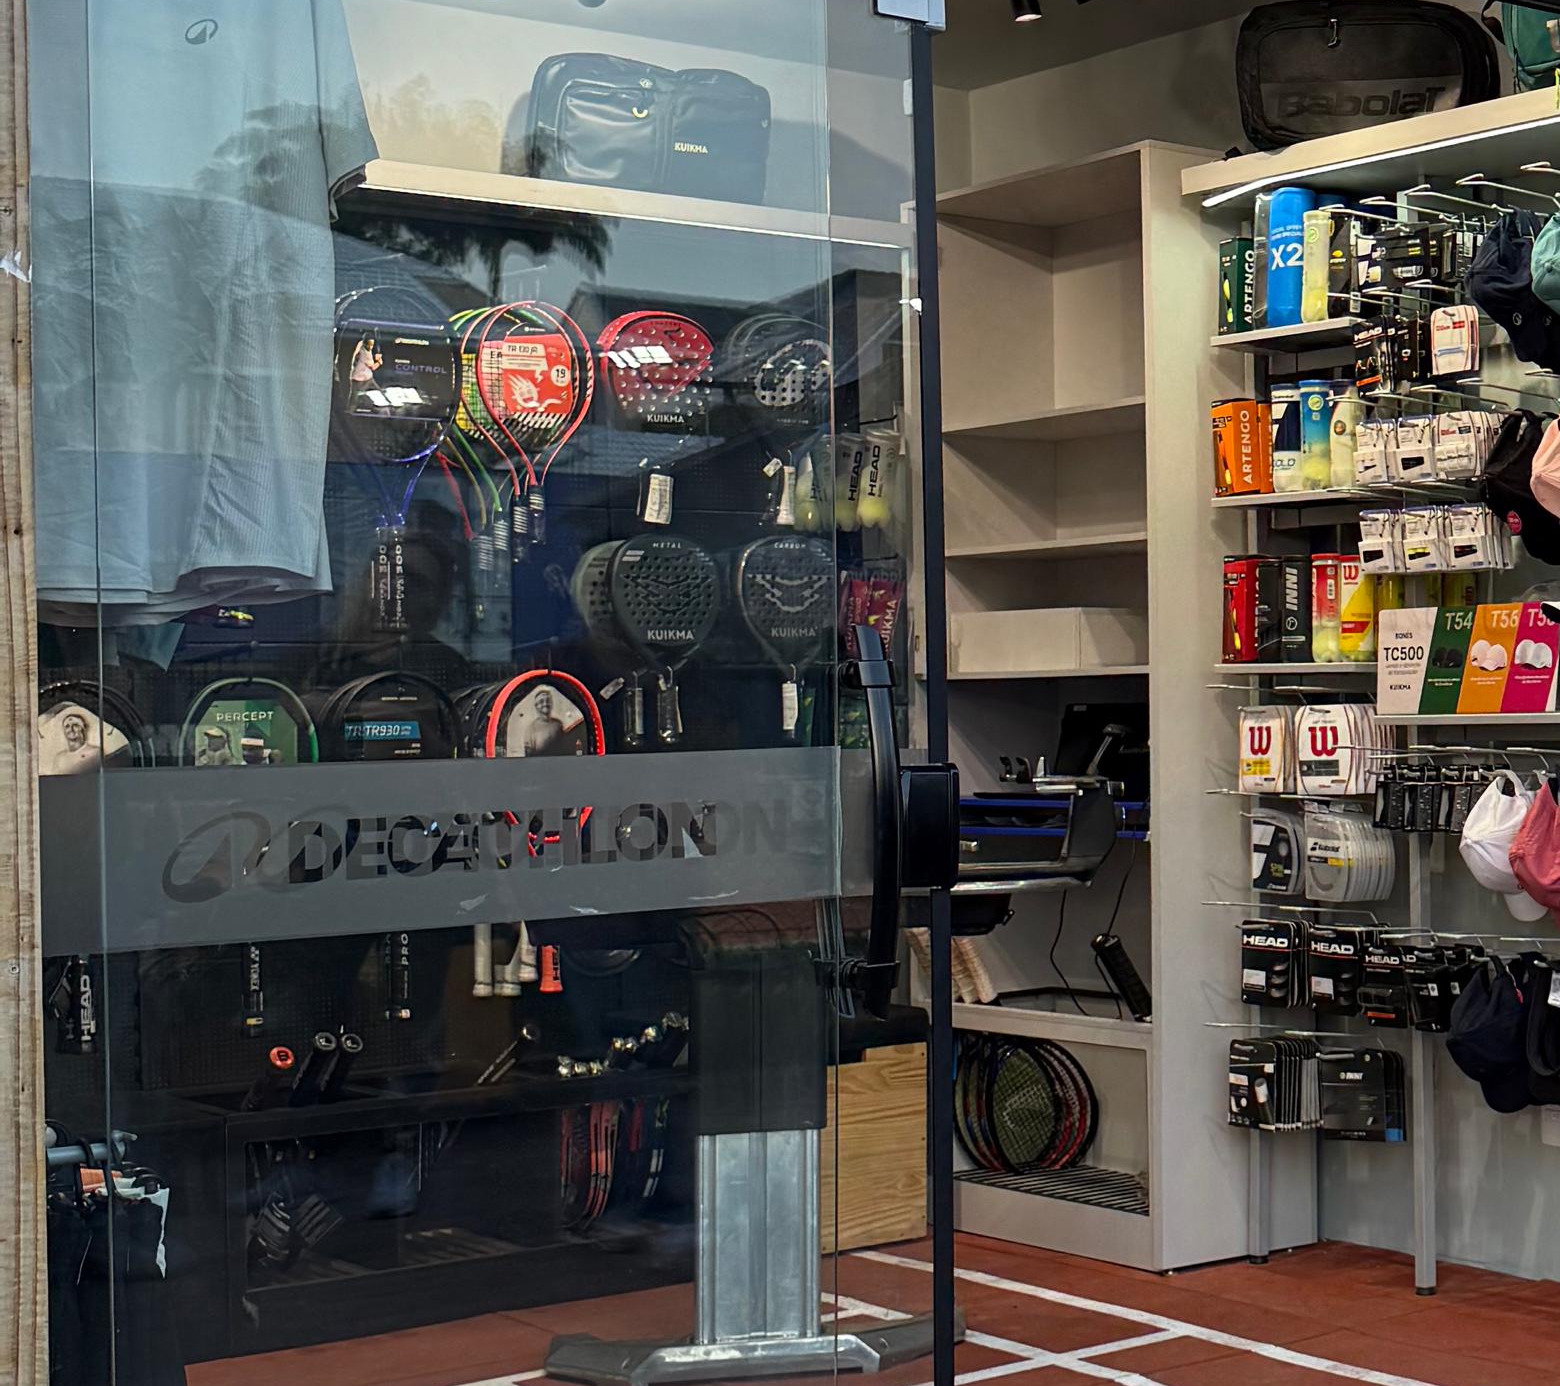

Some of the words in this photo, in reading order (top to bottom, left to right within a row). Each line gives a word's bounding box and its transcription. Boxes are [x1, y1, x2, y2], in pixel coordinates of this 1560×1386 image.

[1270, 243, 1304, 271] X2
[1243, 250, 1255, 324] ARTENGO
[1354, 326, 1382, 341] HEAD
[395, 363, 447, 374] CONTROL
[555, 368, 566, 379] 19
[647, 414, 685, 424] KUIKMA
[1240, 410, 1253, 485] ARTENGO
[849, 450, 863, 501] HEAD
[867, 445, 881, 496] HEAD
[653, 541, 682, 549] METAL
[1446, 612, 1473, 631] T54
[1491, 610, 1519, 629] T56
[647, 629, 694, 641] KUIKMA
[771, 626, 816, 638] KUIKMA
[1383, 646, 1425, 662] TC500
[216, 711, 274, 722] PERCEPT
[366, 724, 400, 737] TR930
[288, 801, 717, 884] DECATHLON
[1242, 934, 1288, 948] HEAD
[1311, 941, 1354, 955] HEAD
[400, 933, 409, 965] PRO
[1365, 954, 1400, 965] HEAD
[80, 974, 93, 1042] HEAD
